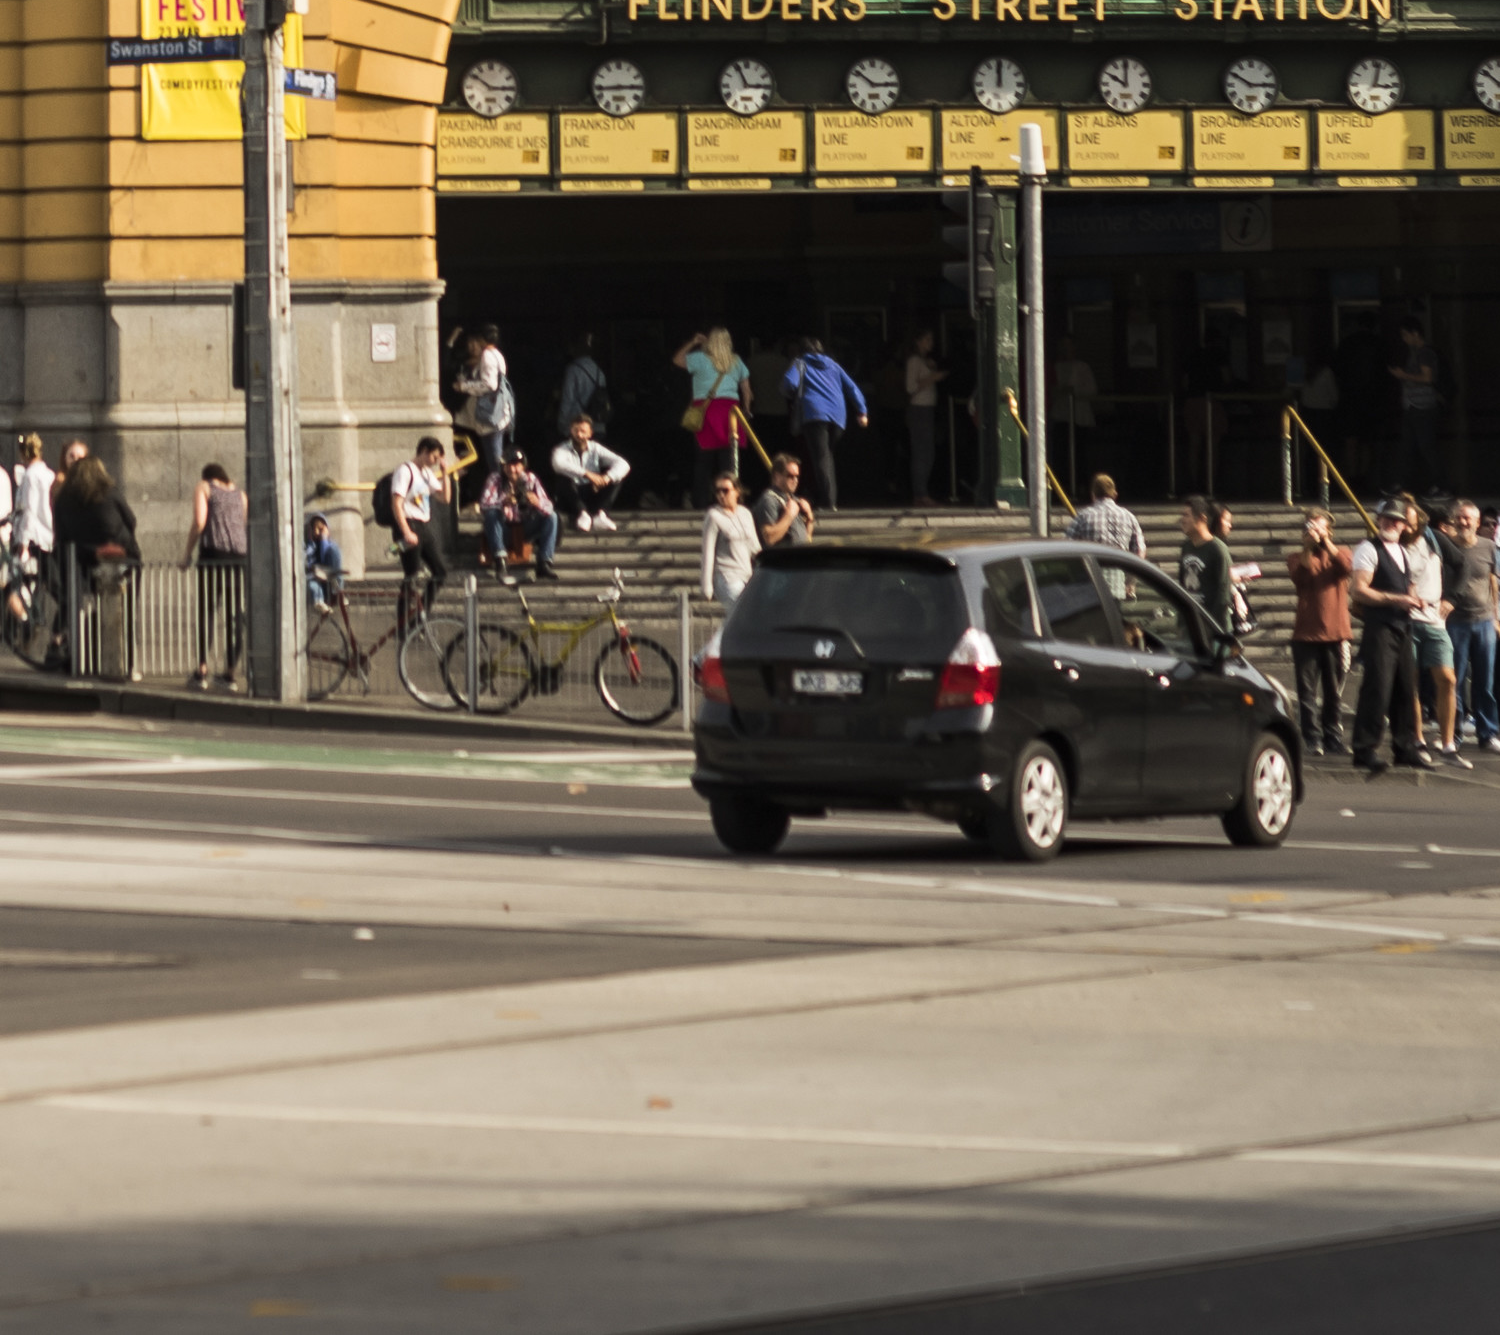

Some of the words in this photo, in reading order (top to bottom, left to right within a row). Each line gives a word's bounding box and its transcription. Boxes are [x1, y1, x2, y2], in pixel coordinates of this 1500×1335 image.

[110, 40, 184, 59] Swanston
[188, 38, 204, 54] St
[440, 118, 498, 131] PAKENHAM
[503, 118, 522, 131] and
[563, 117, 636, 131] FRANKSTON
[694, 117, 782, 130] SANDRINGHAM
[822, 115, 914, 129] WILLIAMSTOWN
[950, 114, 996, 128] ALTONA
[1074, 116, 1092, 128] ST
[1093, 116, 1138, 128] ALBANS
[1200, 115, 1300, 128] BROADMEADOWS
[1325, 115, 1373, 128] UPFIELD
[440, 136, 514, 149] CRANBOURNE
[516, 136, 547, 149] LINES
[564, 135, 590, 148] LINE
[694, 134, 720, 147] LINE
[822, 133, 849, 146] LINE
[950, 132, 975, 144] LINE
[1074, 132, 1100, 145] LINE
[1201, 132, 1226, 145] LINE
[1325, 132, 1351, 145] LINE
[1450, 132, 1476, 145] LINE
[440, 155, 485, 164] PLATFORM
[564, 154, 609, 163] PLATFORM
[694, 153, 740, 163] PLATFORM
[822, 152, 867, 161] PLATFORM
[950, 151, 995, 161] PLATFORM
[1074, 151, 1120, 161] PLATFORM
[1200, 151, 1245, 161] PLATFORM
[1325, 151, 1370, 161] PLATFORM
[1450, 150, 1495, 160] PLATFORM
